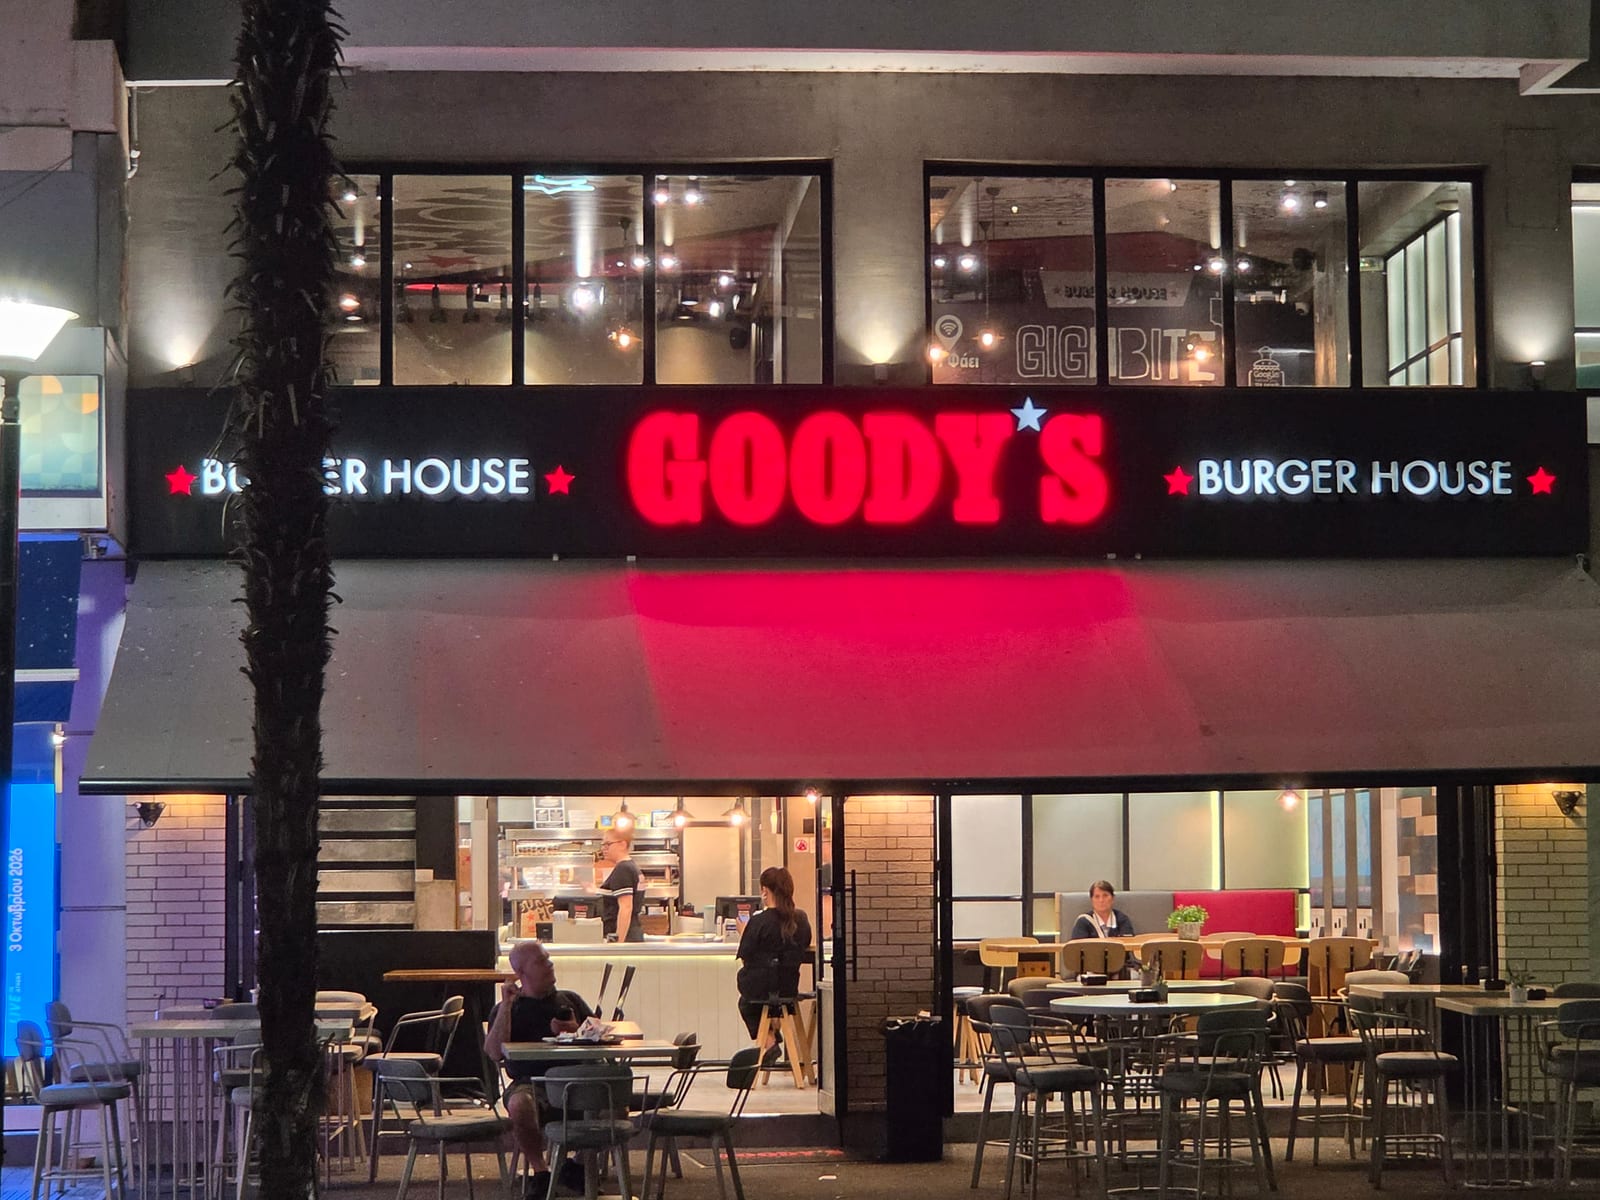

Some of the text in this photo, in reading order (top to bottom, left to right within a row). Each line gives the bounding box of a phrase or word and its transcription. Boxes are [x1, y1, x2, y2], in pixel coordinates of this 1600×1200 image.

[202, 457, 530, 495] BUER HOUSE
[627, 397, 1108, 526] GOODY'S
[1198, 459, 1512, 496] BURGER HOUSE
[8, 847, 23, 877] 2026
[8, 944, 22, 952] 3
